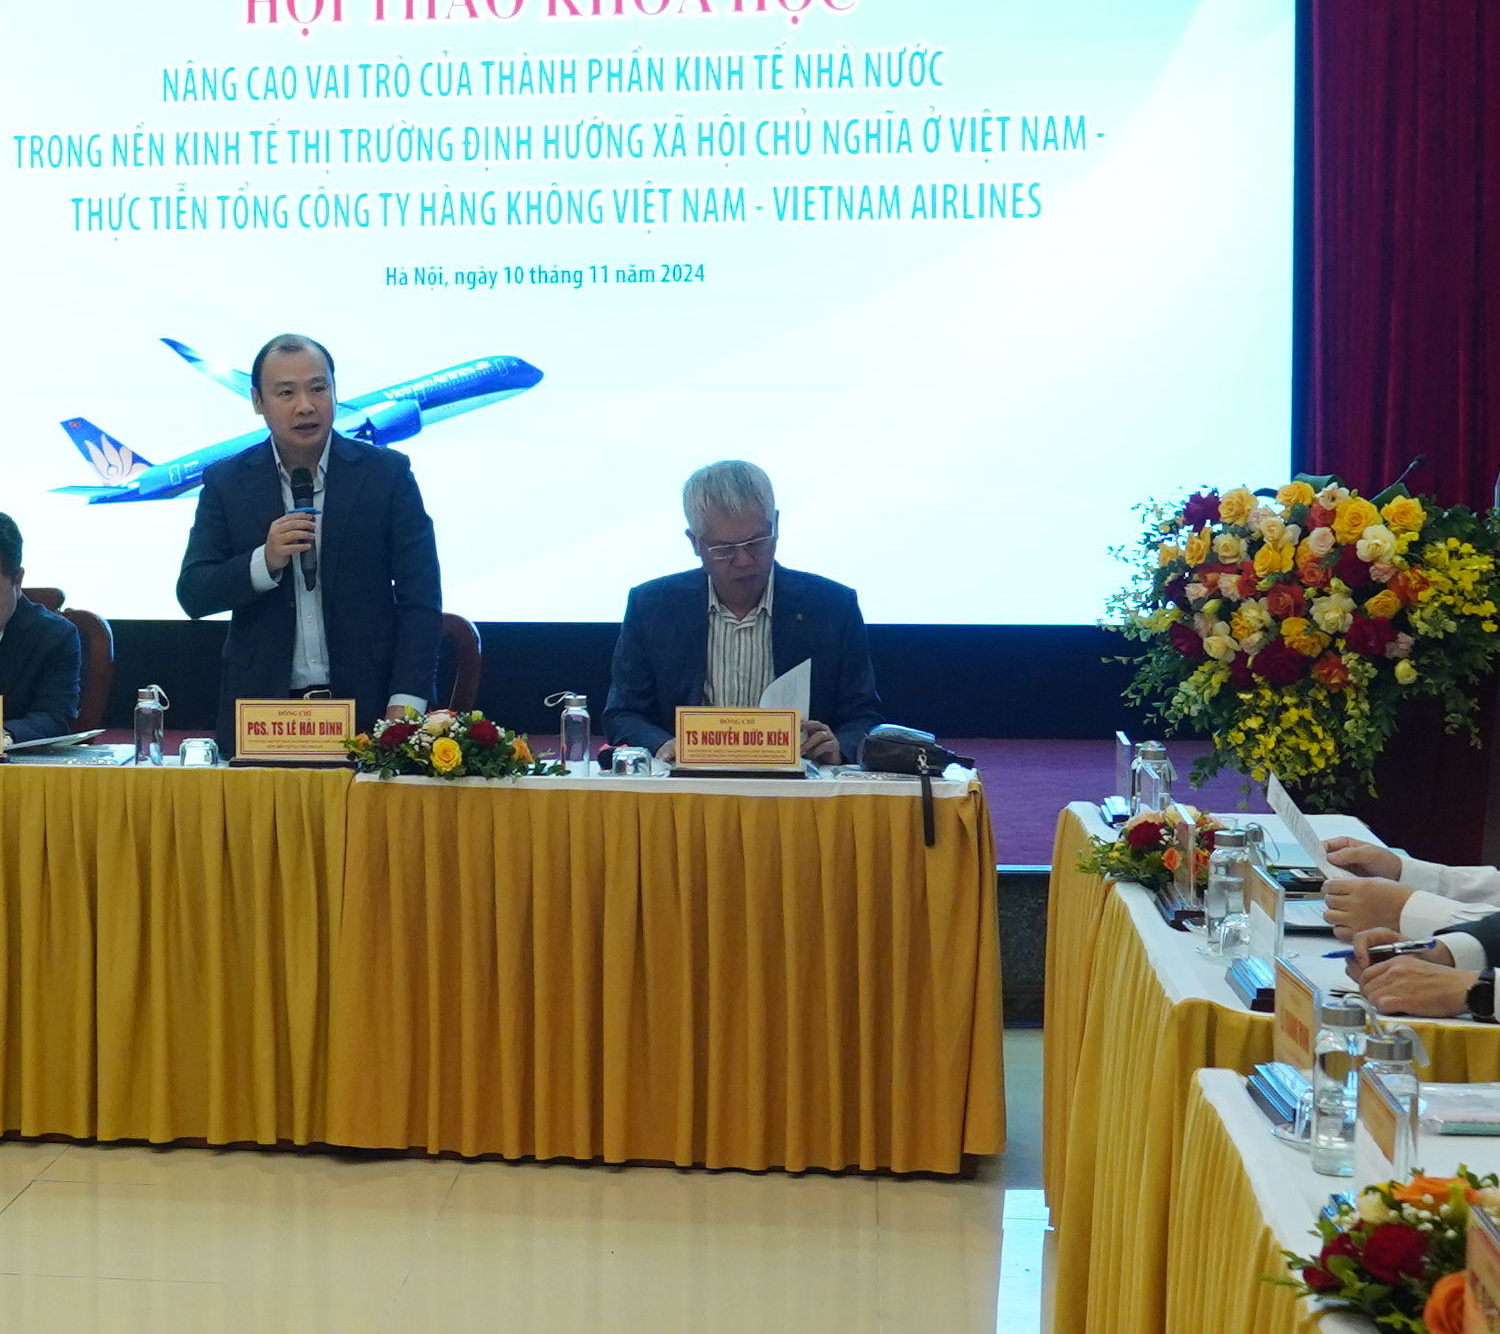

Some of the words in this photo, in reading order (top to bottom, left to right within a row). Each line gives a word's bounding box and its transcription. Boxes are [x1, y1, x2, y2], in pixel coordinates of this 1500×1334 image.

[162, 59, 237, 103] NÂNG
[246, 65, 298, 101] CAO
[305, 64, 350, 100] VAI
[357, 54, 411, 99] TRÒ
[419, 49, 473, 98] CỦA
[480, 51, 577, 96] THÀNH
[587, 45, 664, 94] PHẦN
[675, 55, 744, 92] KINH
[753, 41, 787, 90] TẾ
[794, 44, 855, 89] NHÀ
[864, 42, 944, 88] NƯỚC
[12, 133, 103, 169] TRONG
[112, 121, 165, 168] NỀN
[175, 131, 240, 166] KINH
[248, 122, 279, 165] TẾ
[286, 129, 330, 174] THỊ
[339, 119, 454, 164] TRƯỜNG
[461, 125, 532, 171] ĐỊNH
[543, 115, 644, 160] HƯỚNG
[652, 113, 687, 158] XÃ
[697, 112, 746, 167] HỘI
[755, 109, 812, 157] CHỦ
[823, 109, 913, 155] NGHĨA
[922, 107, 942, 154] Ở
[948, 108, 1012, 163] VIỆT
[1021, 114, 1087, 152] NAM
[70, 192, 142, 242] THỰC
[148, 178, 208, 231] TIỄN
[216, 179, 289, 230] TỔNG
[297, 185, 370, 229] CÔNG
[378, 192, 411, 228] TY
[420, 183, 497, 227] HÀNG
[506, 181, 604, 226] KHÔNG
[612, 180, 673, 234] VIỆT
[682, 186, 746, 223] NAM
[772, 184, 901, 222] VIETNAM
[910, 181, 1042, 220] AIRLINES
[385, 266, 409, 286] Hà
[413, 265, 449, 288] Nội,
[454, 265, 499, 291] ngày
[503, 265, 525, 285] 10
[528, 264, 584, 290] tháng
[588, 264, 609, 284] 11
[615, 263, 656, 284] năm
[659, 263, 706, 283] 2024
[247, 721, 269, 735] PGS.
[271, 721, 284, 735] TS
[299, 718, 316, 735] HẢI
[319, 720, 343, 735] BÌNH
[686, 730, 699, 746] TS
[701, 726, 740, 746] NGUYỄN
[742, 728, 764, 746] ĐỨC
[766, 729, 789, 746] KIÊN
